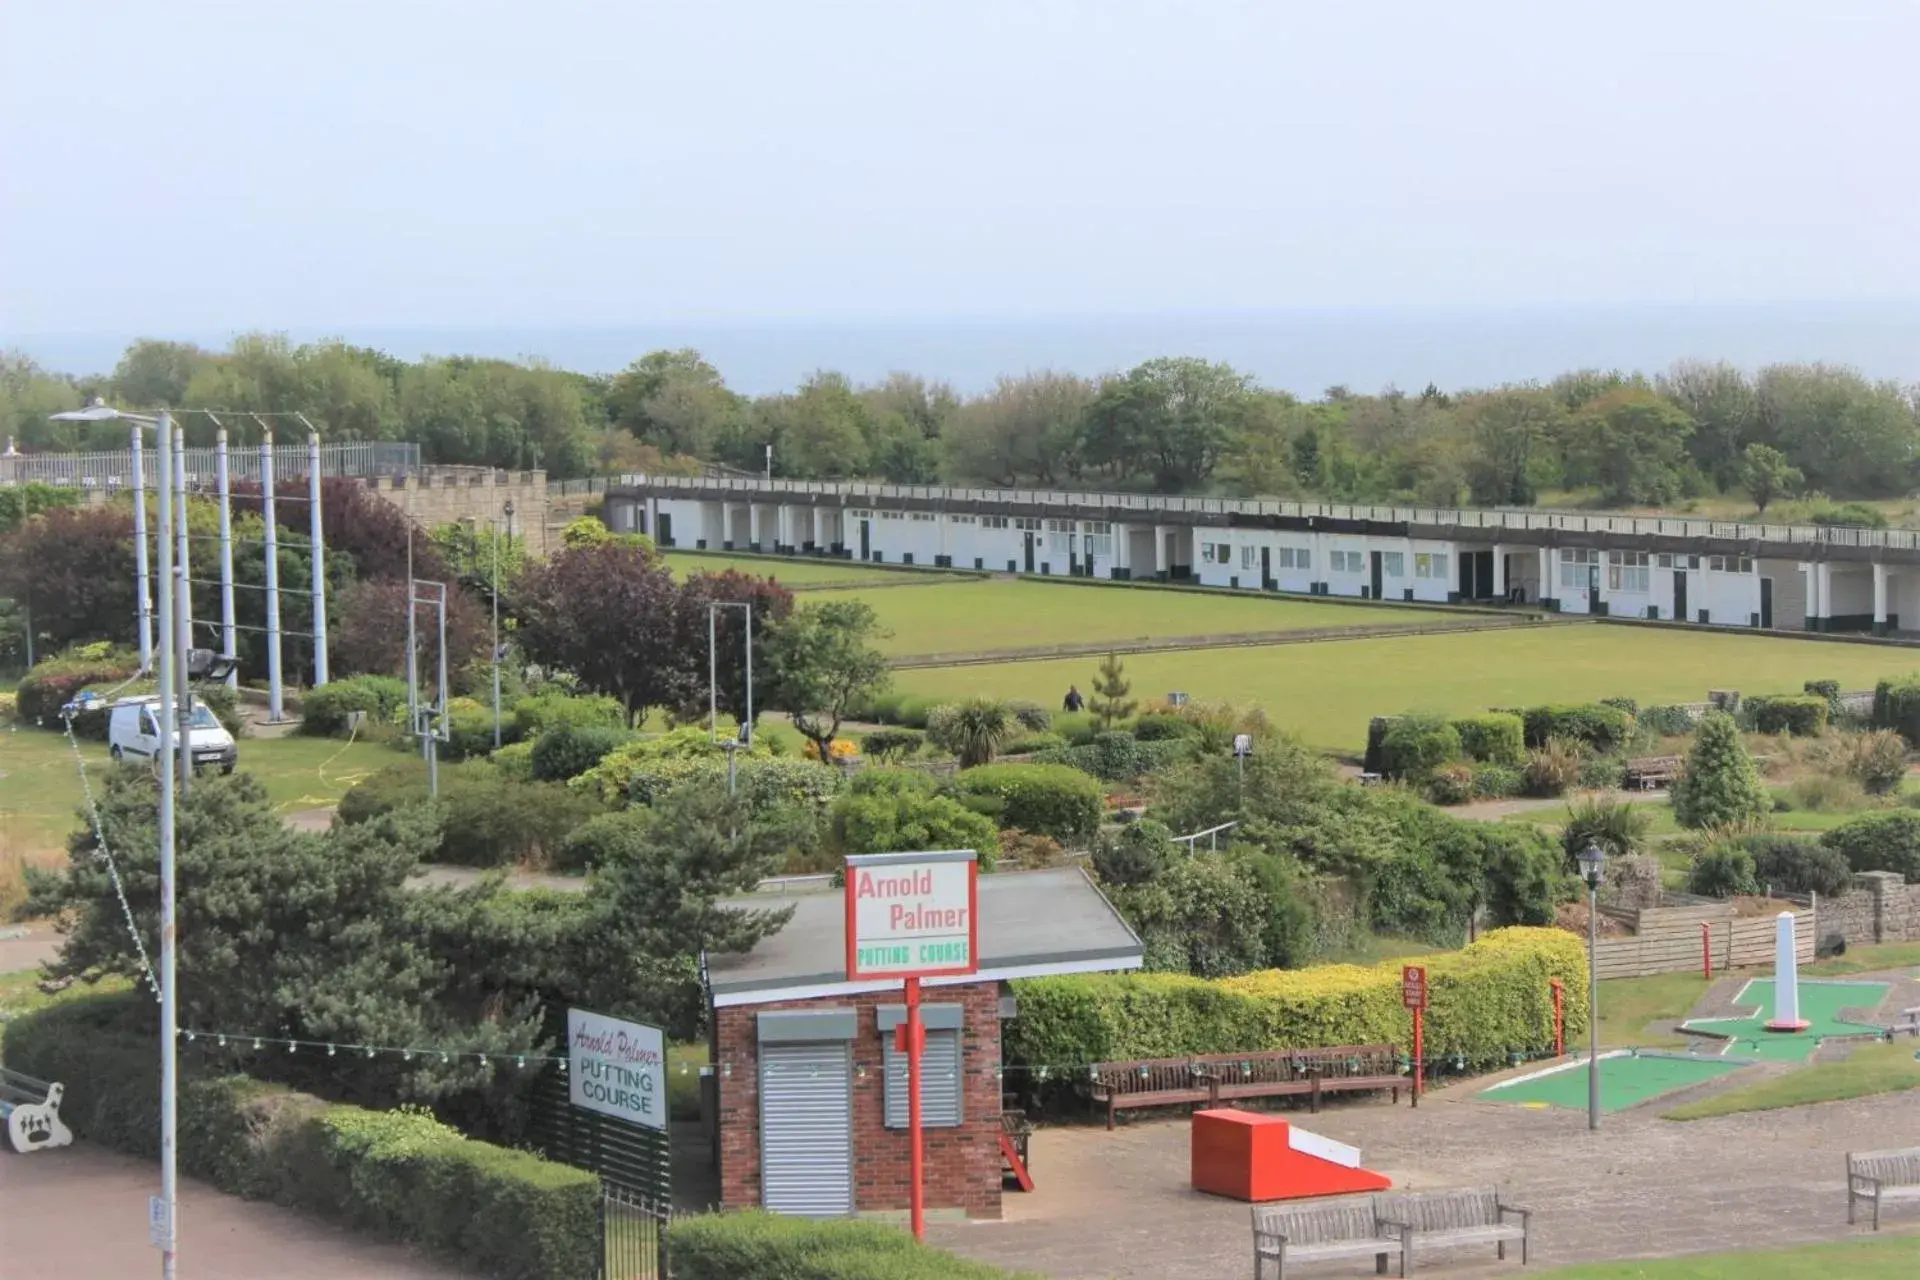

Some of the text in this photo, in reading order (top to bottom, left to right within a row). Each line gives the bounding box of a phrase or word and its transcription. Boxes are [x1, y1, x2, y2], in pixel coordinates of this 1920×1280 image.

[858, 869, 932, 898] Arnold
[890, 903, 966, 931] Palmer
[858, 942, 968, 966] PUTTING COURSE
[581, 1057, 653, 1092] PUTTING
[583, 1080, 652, 1114] COURSE
